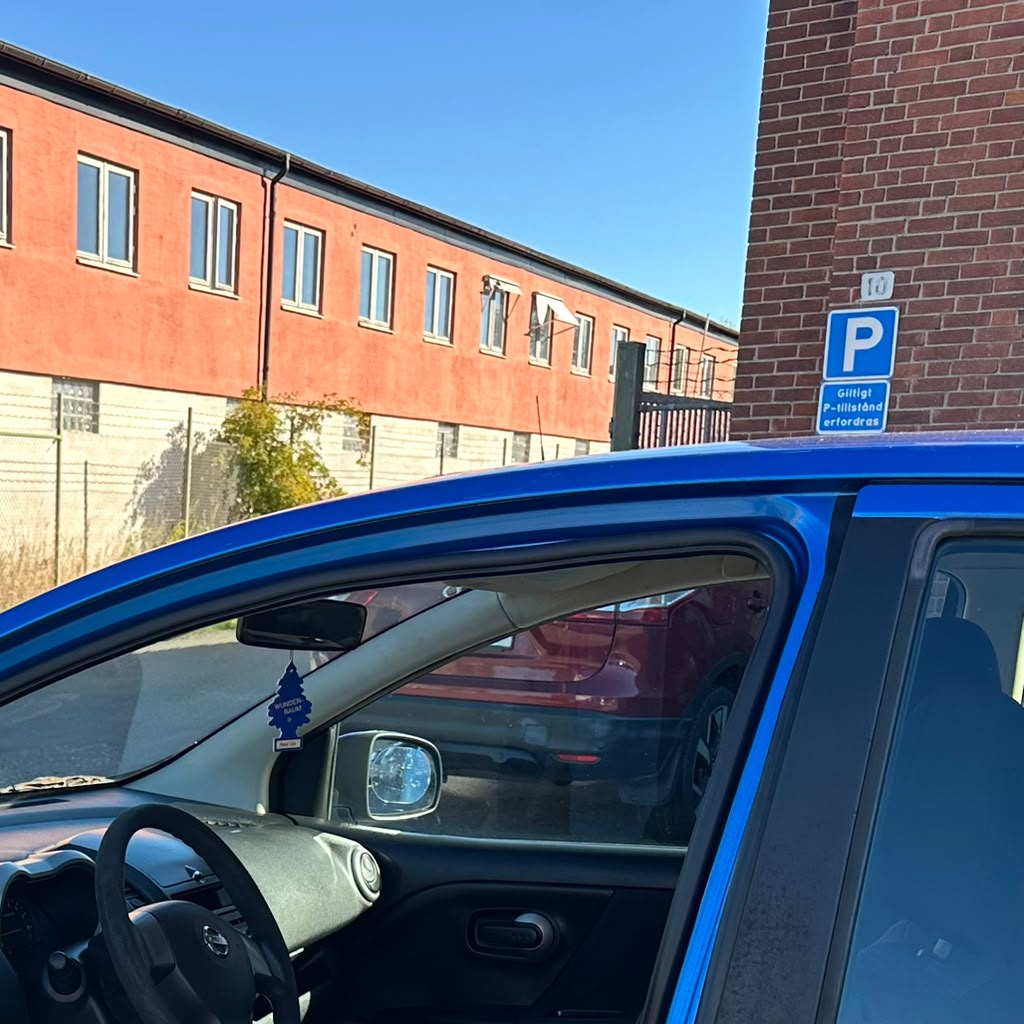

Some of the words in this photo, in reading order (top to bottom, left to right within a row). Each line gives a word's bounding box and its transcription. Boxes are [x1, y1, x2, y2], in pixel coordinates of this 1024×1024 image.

[843, 316, 884, 372] P
[837, 387, 872, 400] Giltigt
[823, 402, 883, 413] P-tillstånd
[823, 416, 880, 427] erfordras
